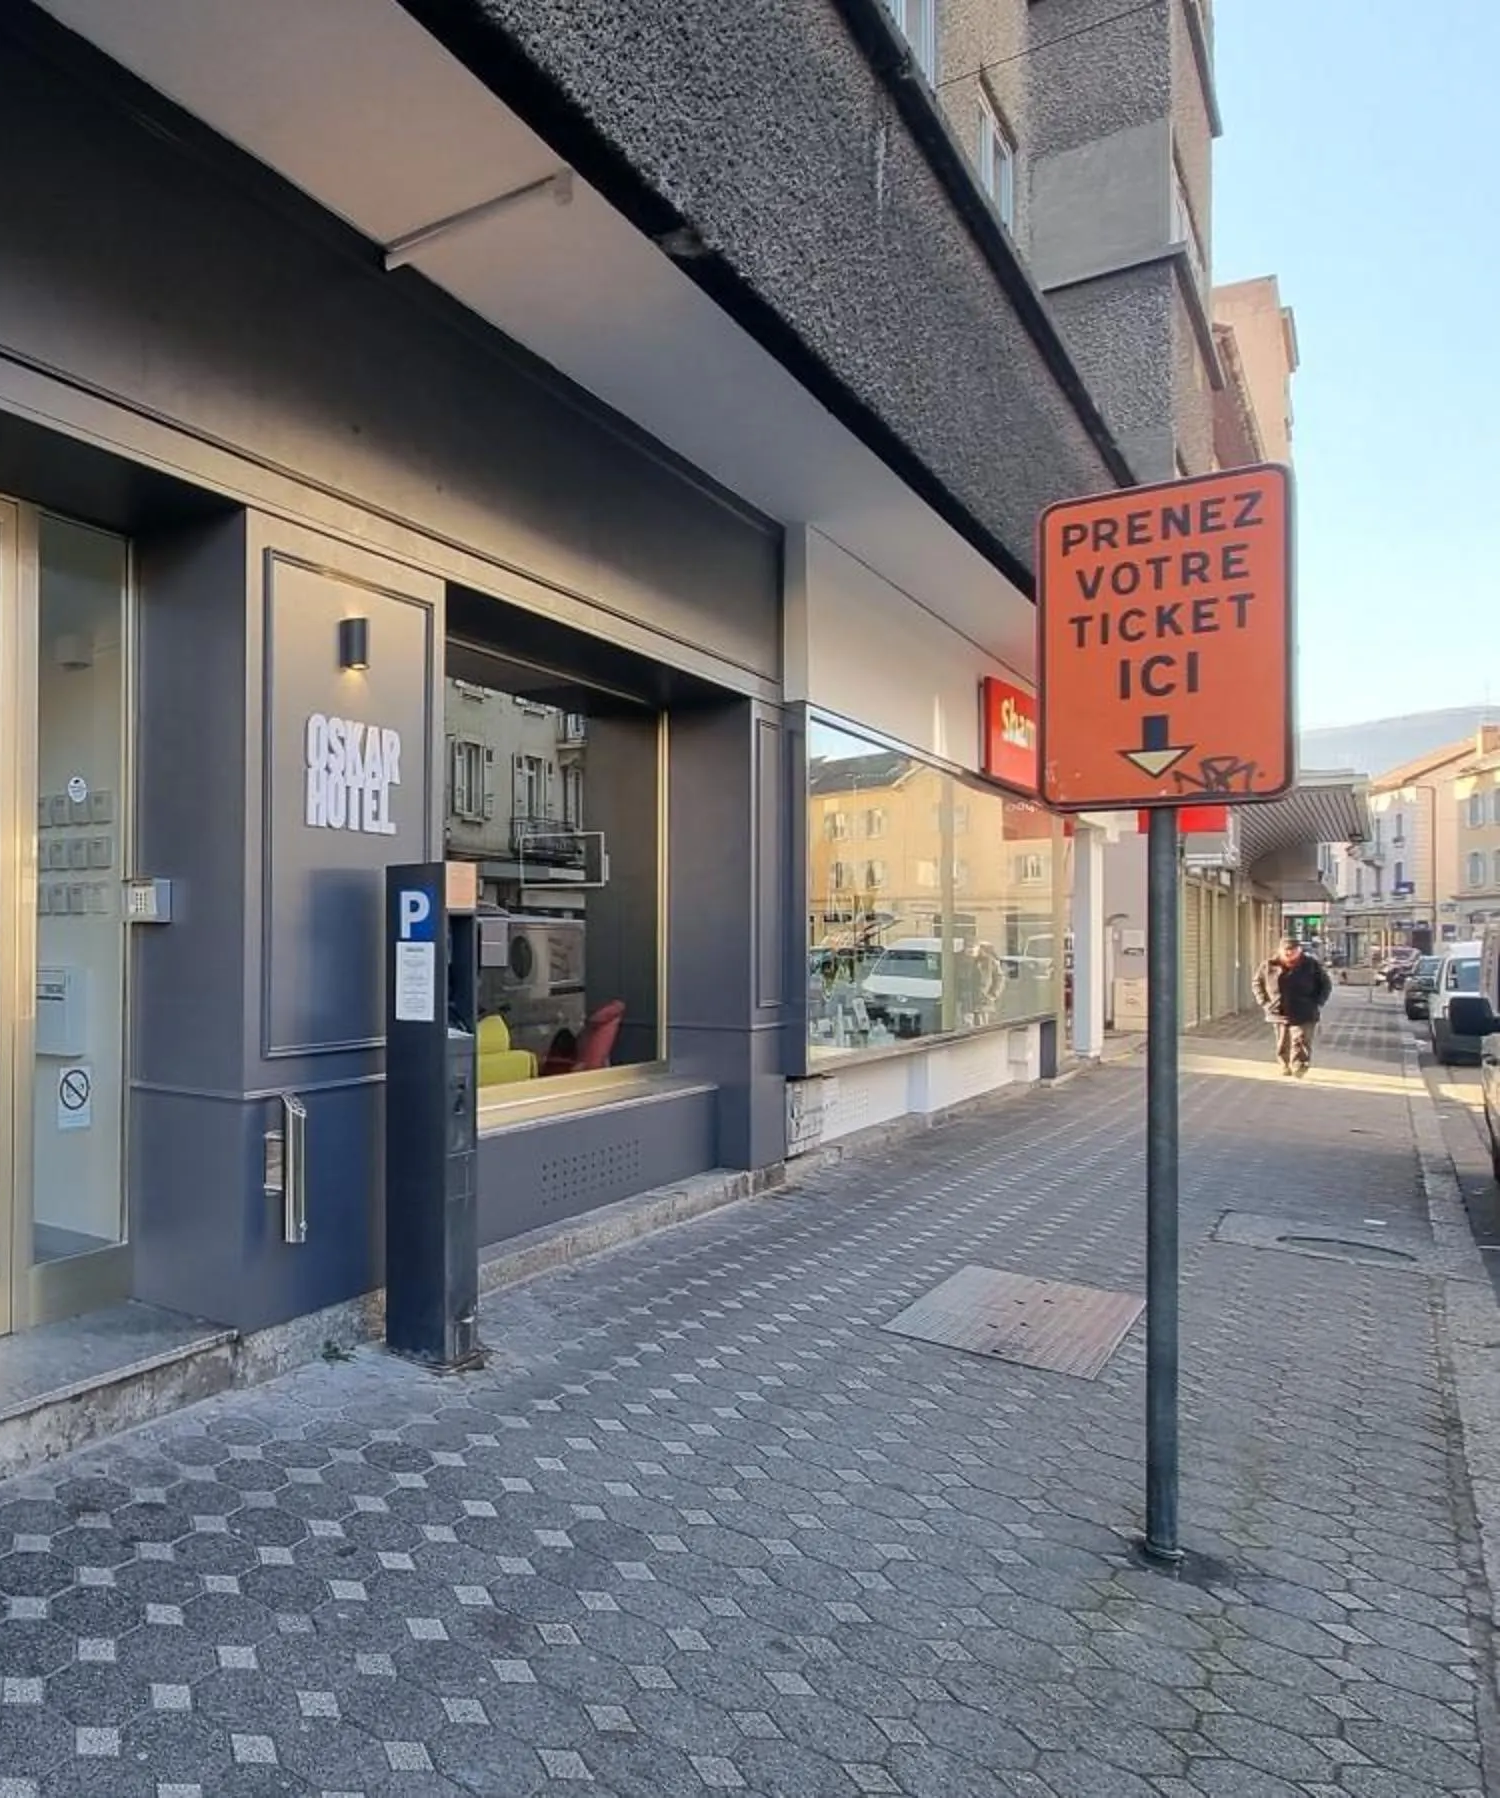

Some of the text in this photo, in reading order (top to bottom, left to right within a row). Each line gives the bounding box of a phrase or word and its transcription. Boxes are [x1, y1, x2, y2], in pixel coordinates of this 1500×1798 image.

[1061, 490, 1263, 556] PRENEZ
[1076, 544, 1250, 600] VOTRE
[1069, 593, 1255, 648] TICKET
[1120, 652, 1199, 700] ICI
[306, 713, 400, 785] OSKAR
[305, 766, 397, 834] HOTEL
[400, 890, 430, 939] P
